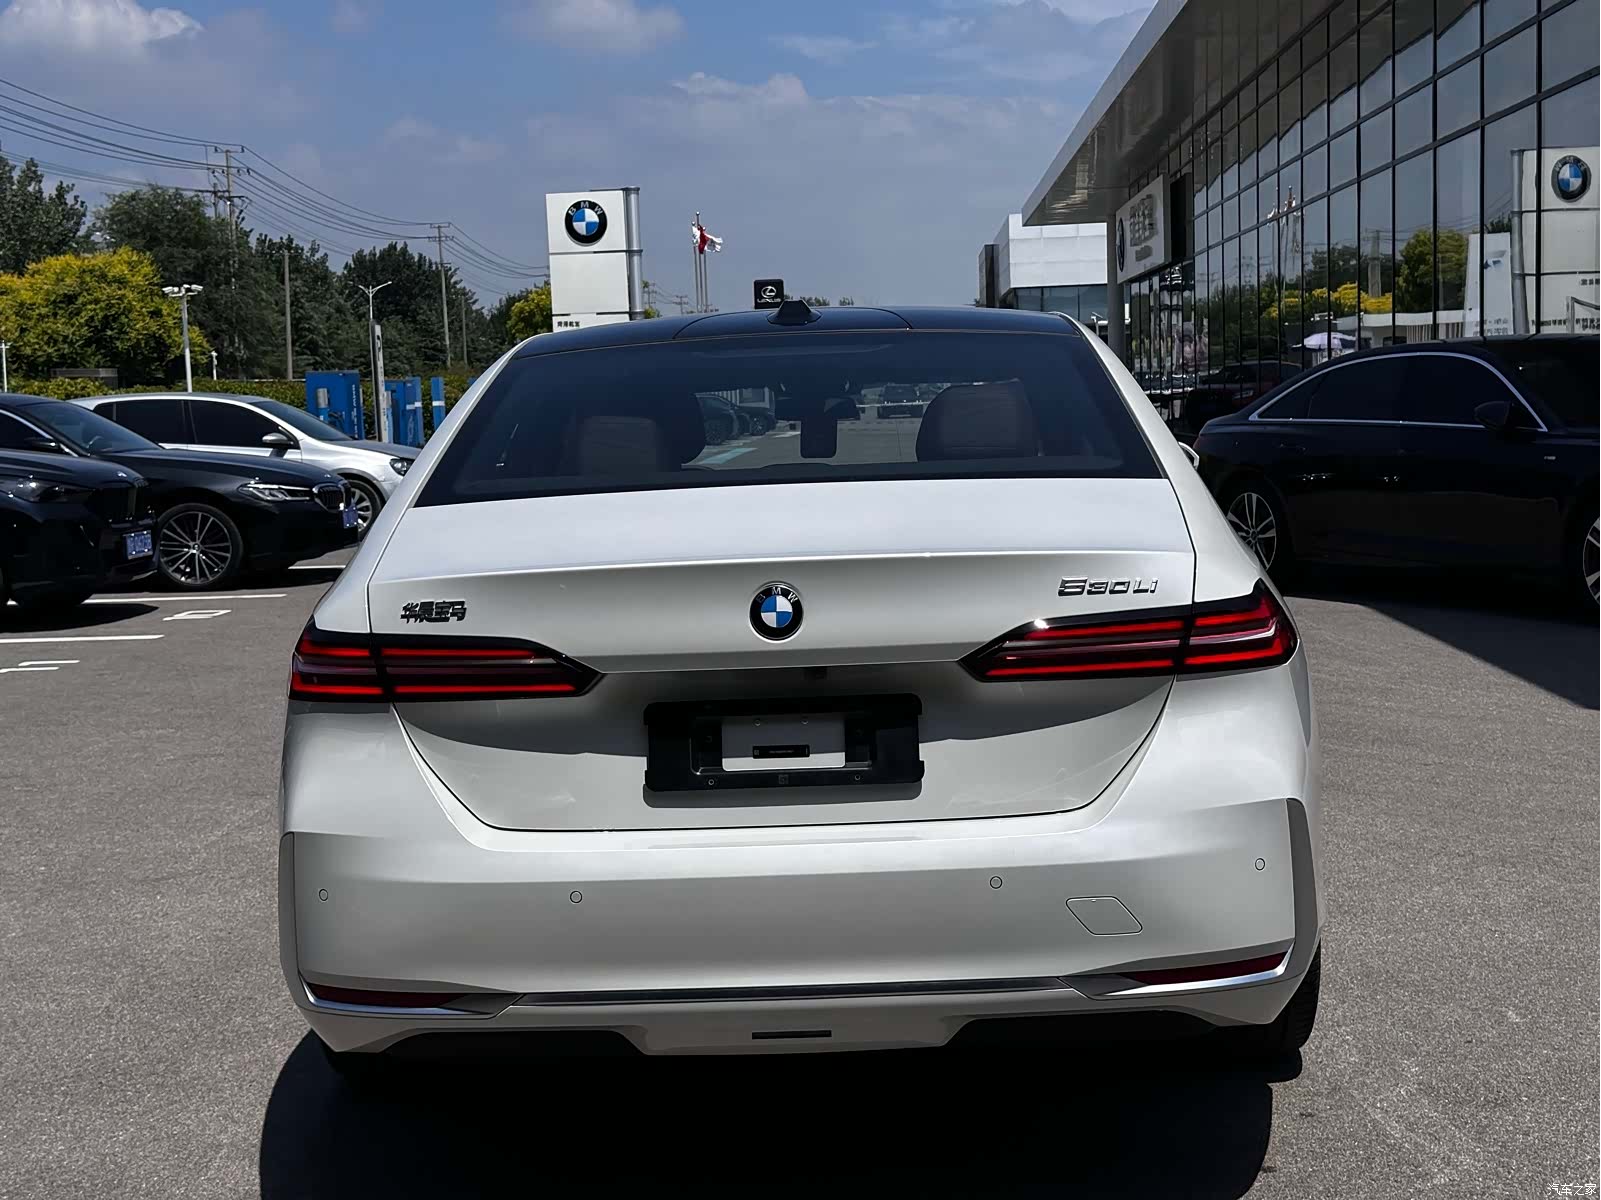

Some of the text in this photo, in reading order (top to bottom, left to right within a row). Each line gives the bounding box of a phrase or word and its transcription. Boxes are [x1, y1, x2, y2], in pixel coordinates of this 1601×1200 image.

[568, 201, 604, 216] BMW
[756, 586, 798, 603] BMW
[1058, 577, 1158, 596] 530Li
[400, 600, 467, 624] 华晨宝马
